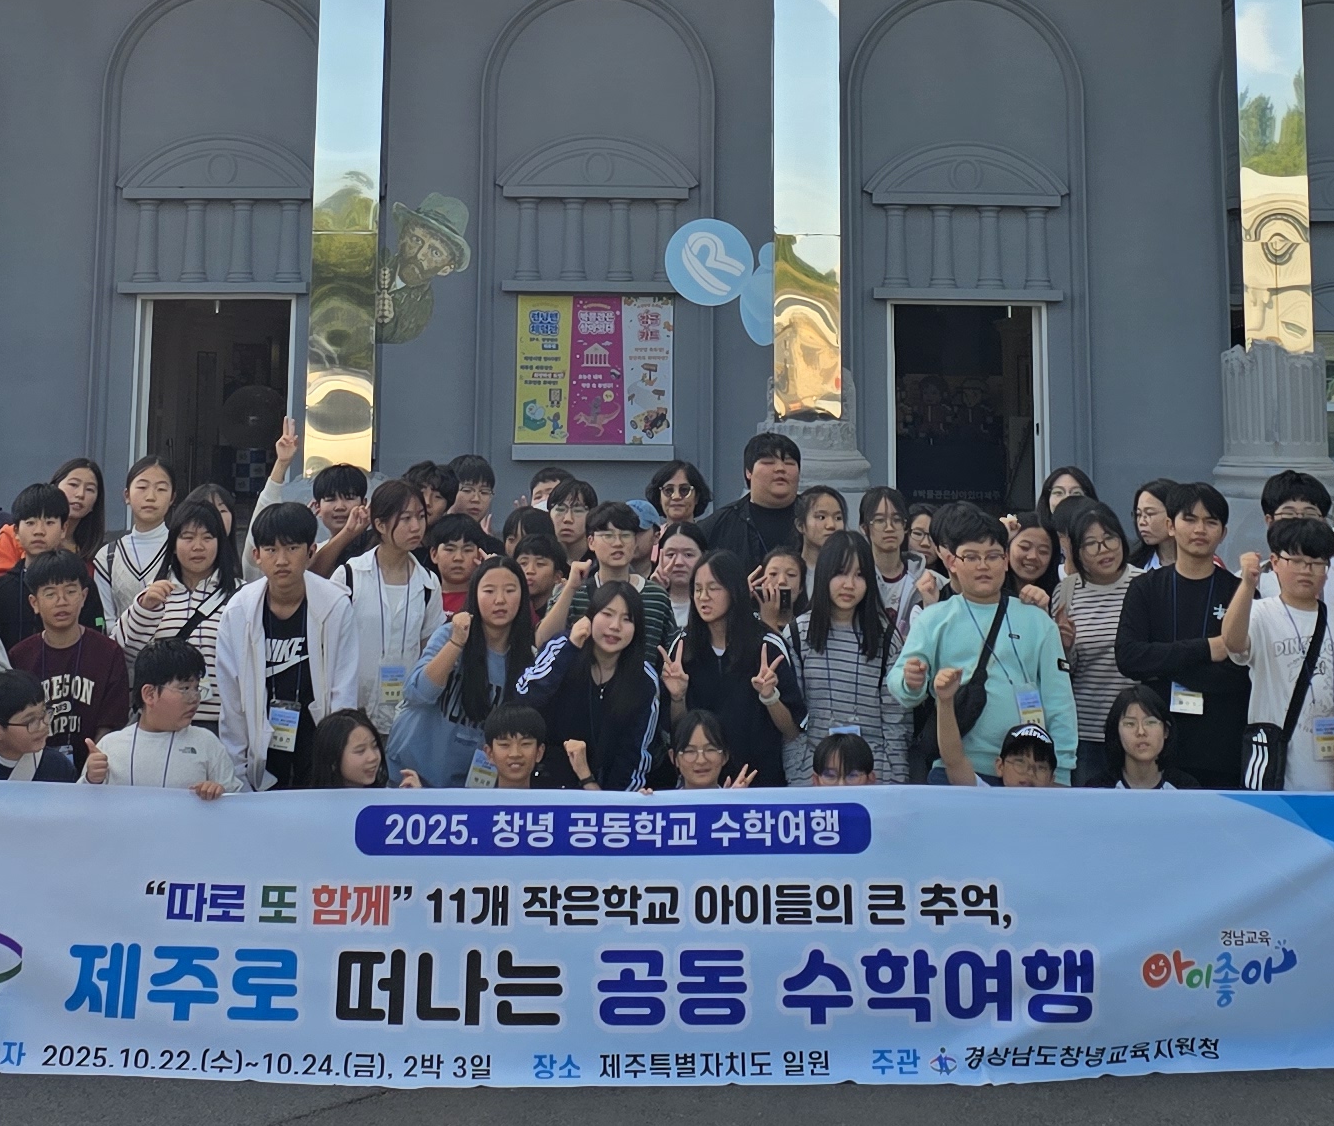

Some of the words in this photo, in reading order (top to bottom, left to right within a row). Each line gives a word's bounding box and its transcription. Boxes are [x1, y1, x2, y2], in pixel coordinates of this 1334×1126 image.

[384, 813, 479, 846] 2025.
[492, 811, 554, 849] 창녕
[568, 811, 698, 849] 공동학교
[710, 809, 841, 847] 수학여행
[258, 885, 298, 924] 또
[426, 885, 509, 926] 11개
[522, 885, 681, 926] 작은학교
[694, 883, 854, 926] 아이들의
[867, 884, 907, 926] 큰
[919, 883, 1013, 930] 추억,
[1220, 929, 1272, 947] 경남교육
[64, 942, 300, 1022] 제주로
[335, 948, 564, 1026] 떠나는
[596, 949, 749, 1026] 공동
[781, 947, 1096, 1026] 수학여행
[1141, 947, 1298, 1009] 아이좋아
[41, 1044, 394, 1081] 2025.10.22.(수)~10.24.(금),
[403, 1053, 445, 1080] 2박
[452, 1053, 492, 1080] 3일
[532, 1053, 582, 1080] 장소
[598, 1050, 773, 1080] 제주특별자치도
[782, 1049, 831, 1078] 일원
[871, 1047, 921, 1076] 주관
[964, 1036, 1222, 1071] 경상남도창녕교육지원청
